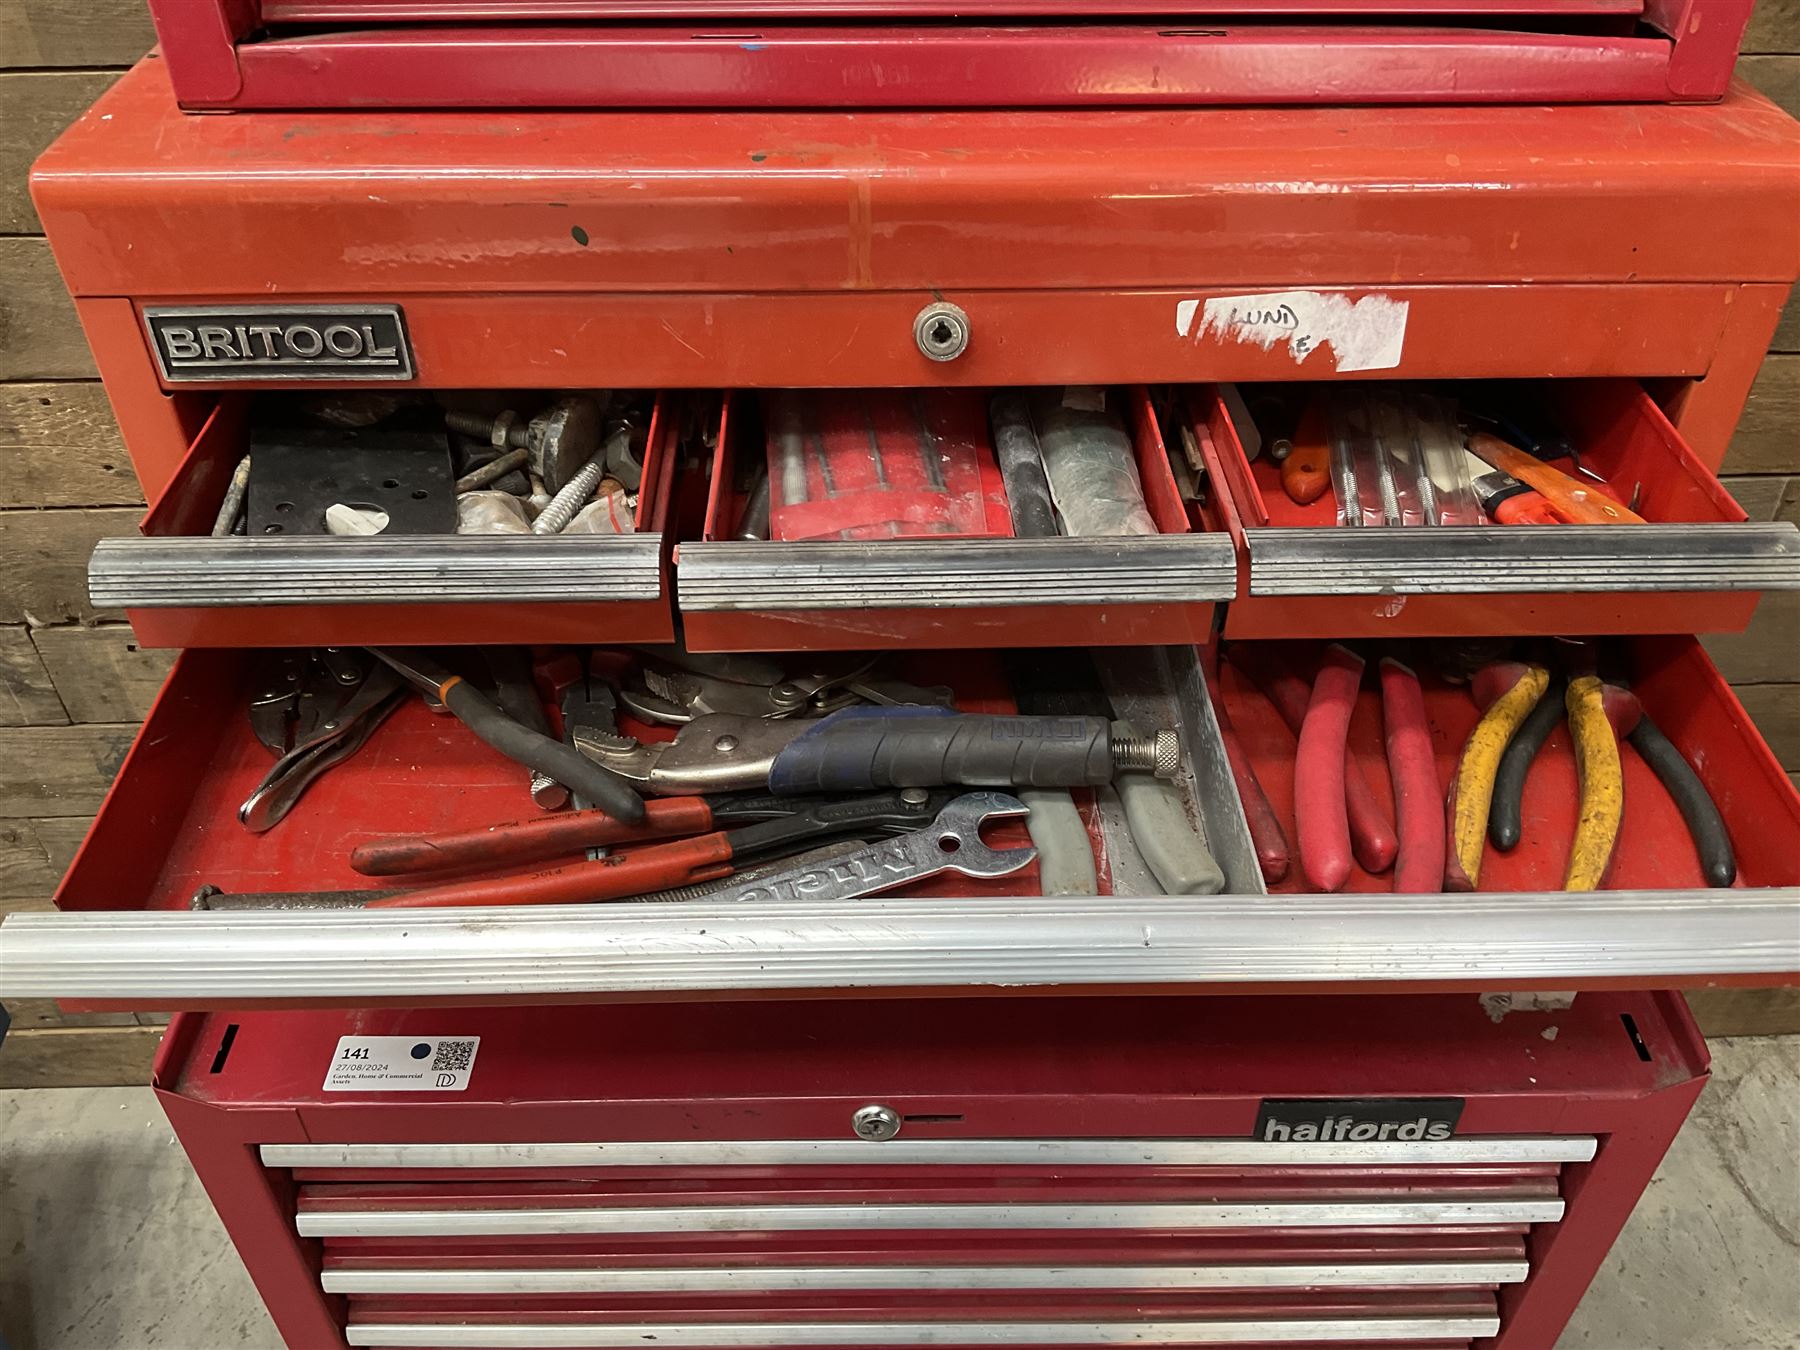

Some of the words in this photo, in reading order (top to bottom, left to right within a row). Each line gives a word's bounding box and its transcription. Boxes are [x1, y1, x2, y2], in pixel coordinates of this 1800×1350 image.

[161, 325, 396, 358] BRITOOL
[341, 1047, 370, 1060] 141
[335, 1063, 389, 1072] 27/08/2024
[1264, 1116, 1451, 1142] halfords
